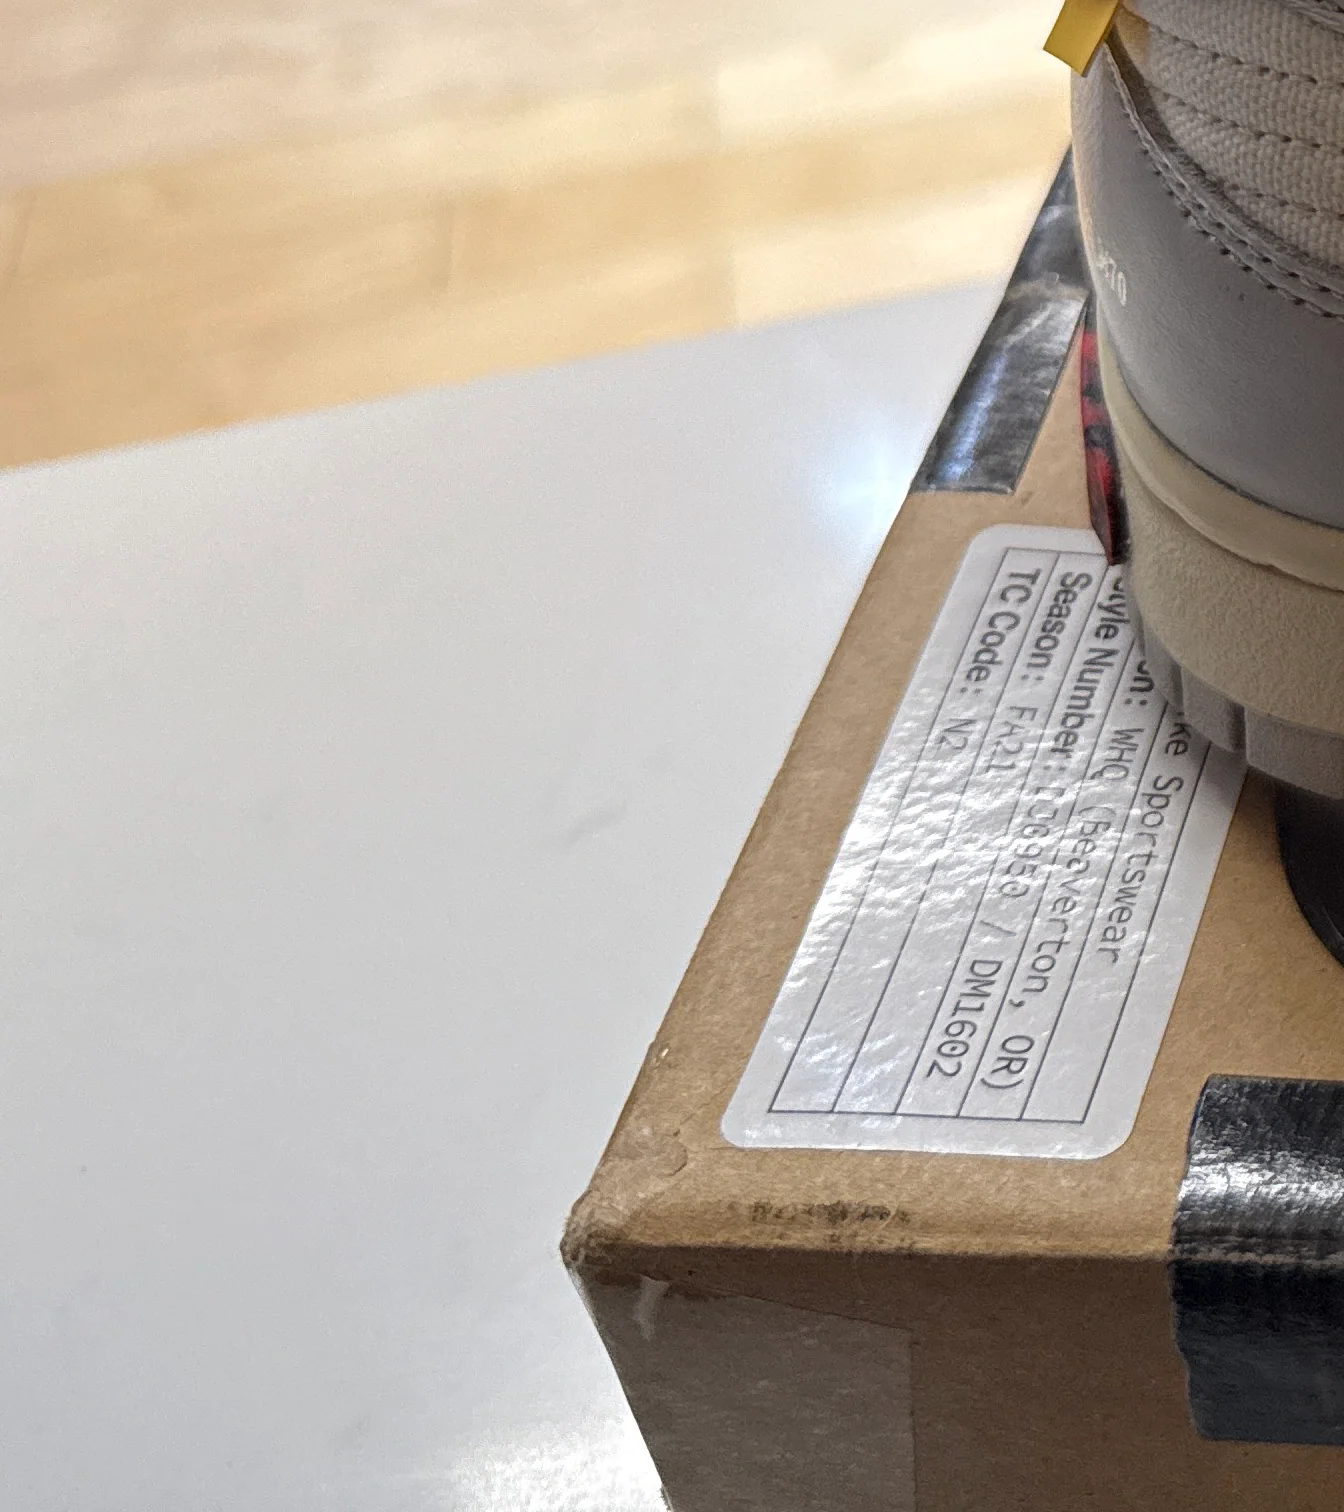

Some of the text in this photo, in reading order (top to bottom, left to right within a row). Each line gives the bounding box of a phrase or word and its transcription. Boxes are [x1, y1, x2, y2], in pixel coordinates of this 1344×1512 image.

[1000, 567, 1043, 604] TC
[960, 611, 1021, 694] Code:
[985, 572, 1093, 774] Season: FA21
[1043, 647, 1120, 771] Number:
[1091, 728, 1146, 781] WHQ
[1008, 806, 1117, 1008] (Beaverton,
[1098, 775, 1184, 964] Sportswear
[926, 959, 1004, 1079] DM1602
[980, 1034, 1036, 1090] OR)
